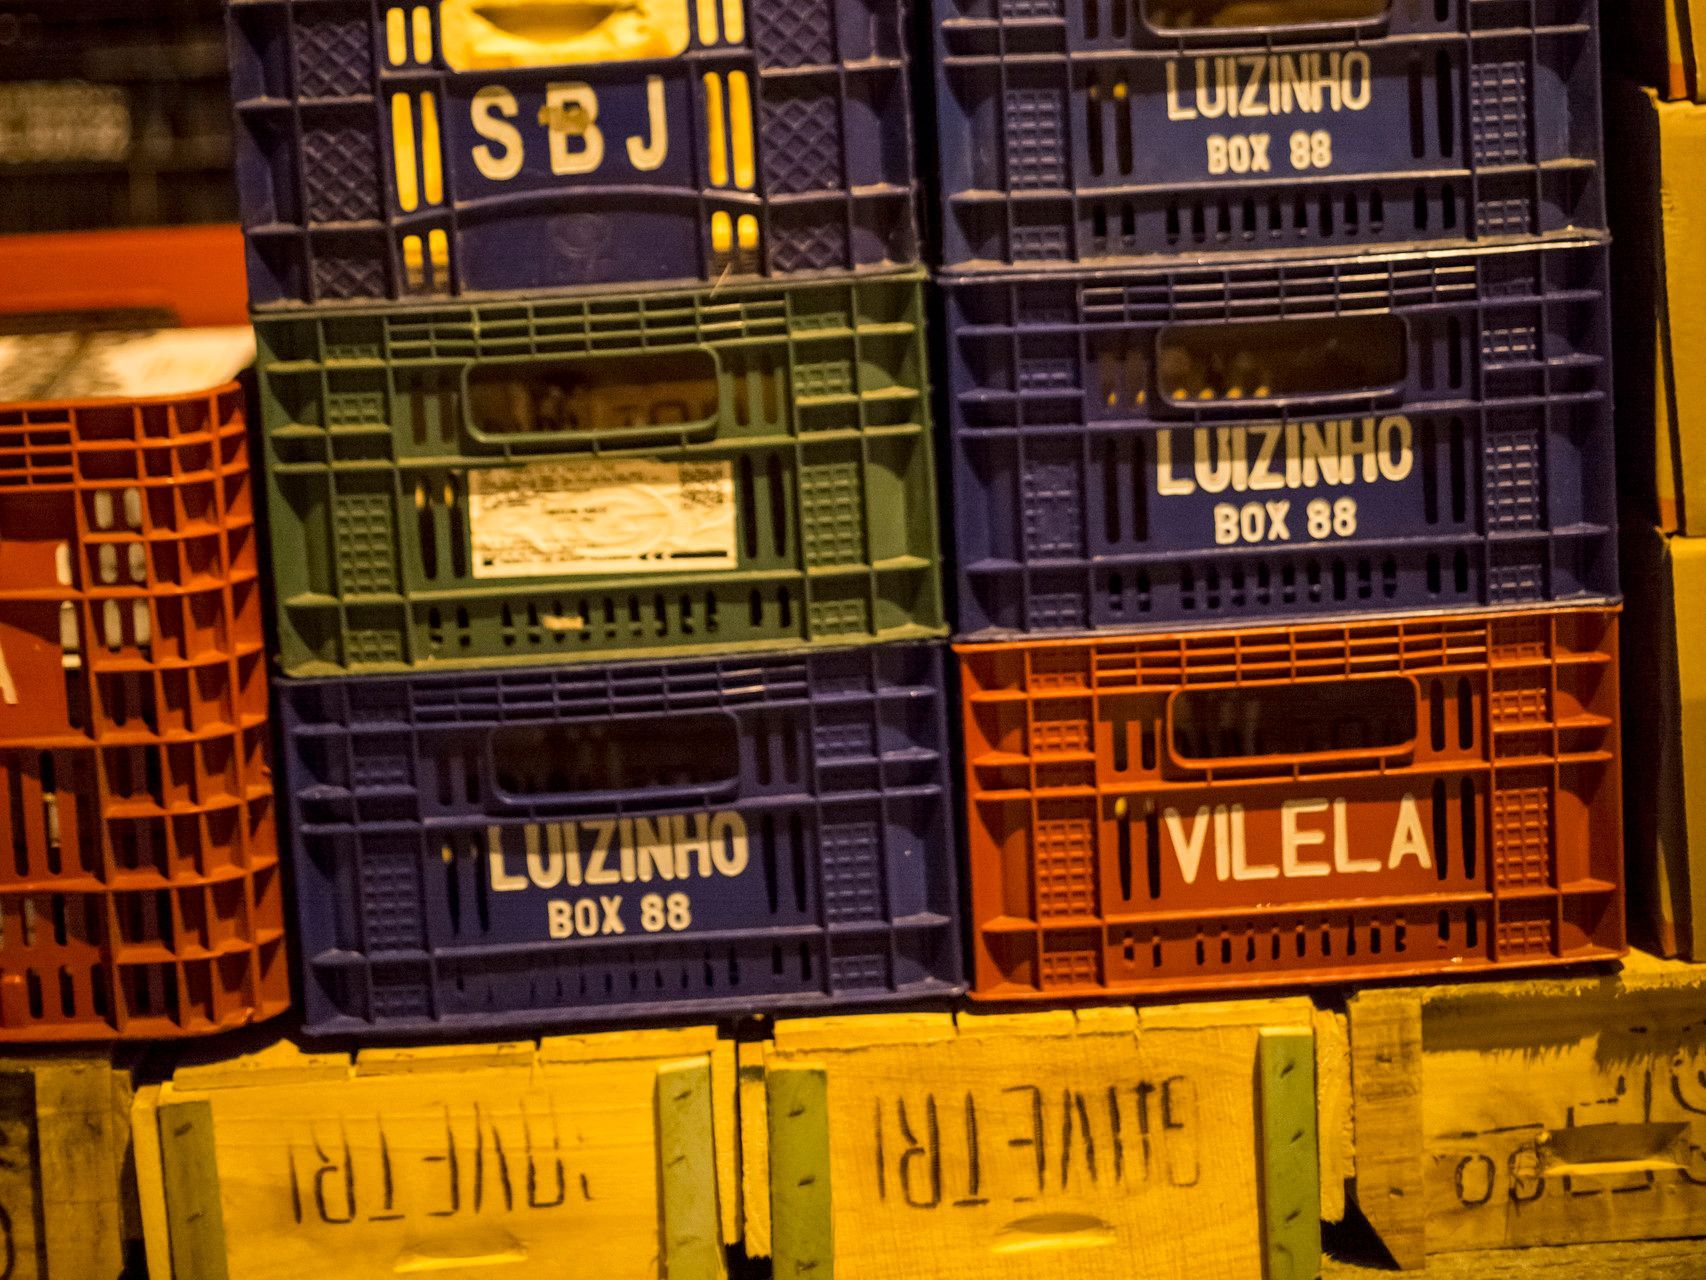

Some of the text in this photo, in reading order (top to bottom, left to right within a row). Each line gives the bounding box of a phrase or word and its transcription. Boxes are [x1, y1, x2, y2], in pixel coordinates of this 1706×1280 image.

[1166, 50, 1372, 122] LUIZINHO
[1206, 129, 1334, 176] BOX 88
[1156, 415, 1414, 497] LUIZINHO
[1213, 497, 1358, 546] BOX 88
[488, 810, 750, 893] LUIZINHO
[1165, 795, 1432, 883] VILELA
[547, 891, 693, 940] BOX 88
